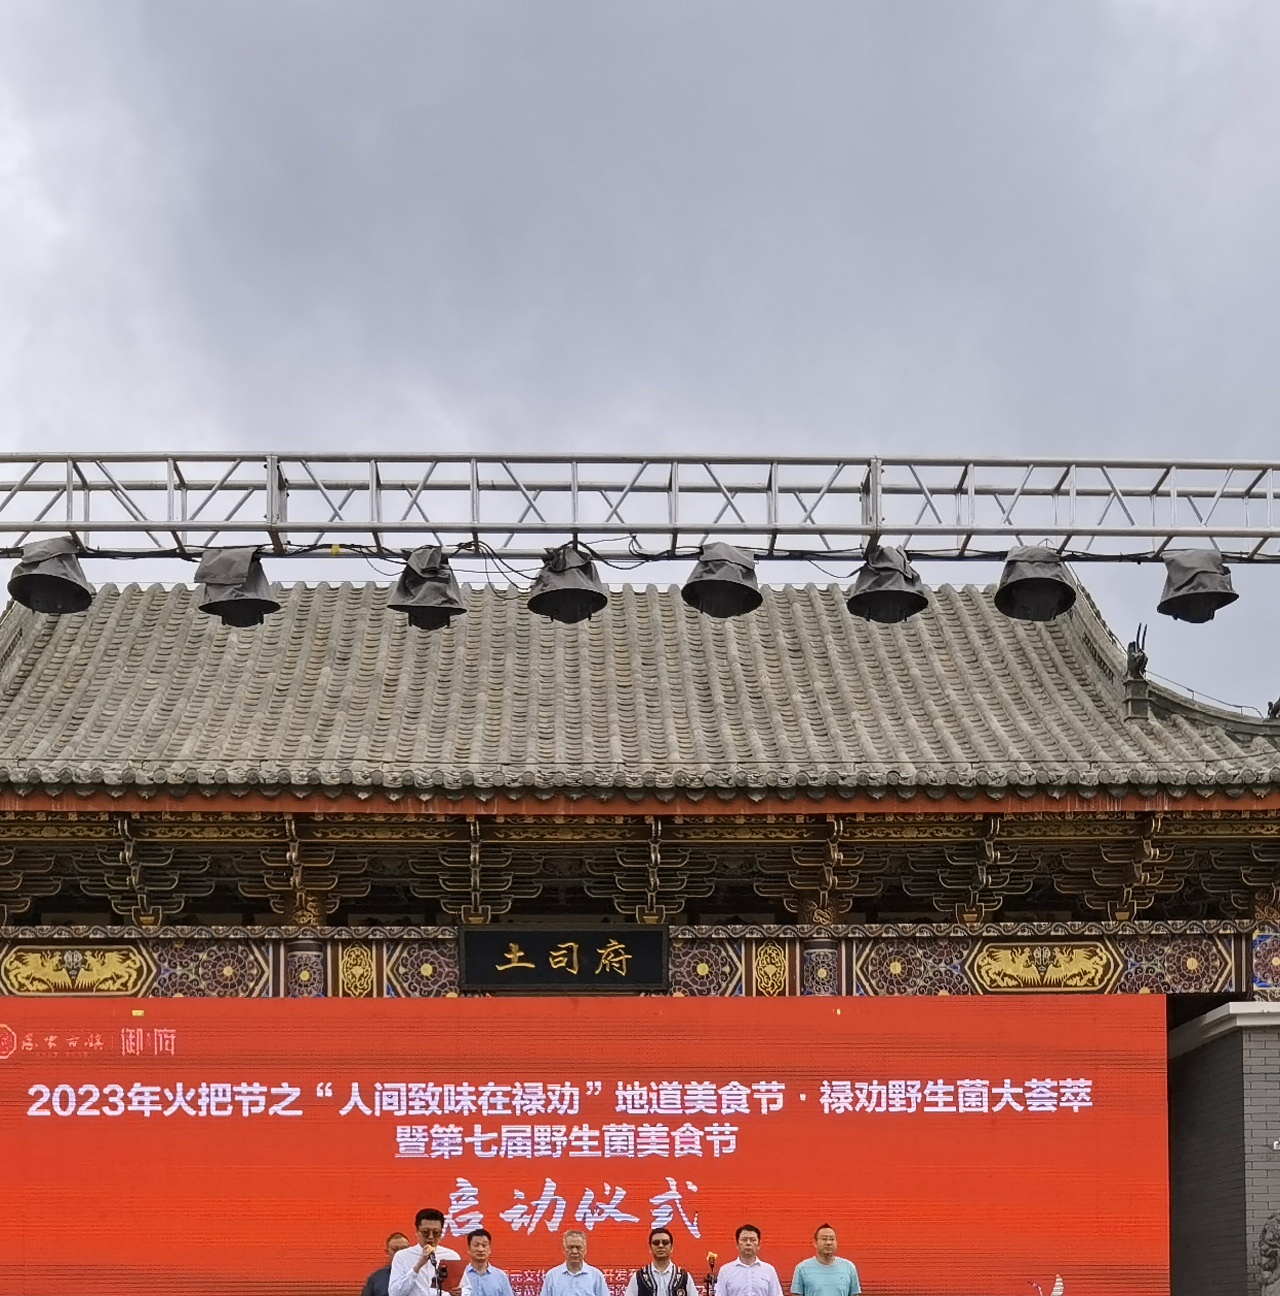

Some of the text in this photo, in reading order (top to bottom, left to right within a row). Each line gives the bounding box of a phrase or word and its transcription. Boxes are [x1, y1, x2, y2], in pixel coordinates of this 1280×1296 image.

[495, 938, 633, 977] 土司府
[394, 1123, 740, 1160] 暨第七届野生菌美食节
[441, 1176, 703, 1239] 启动仪式
